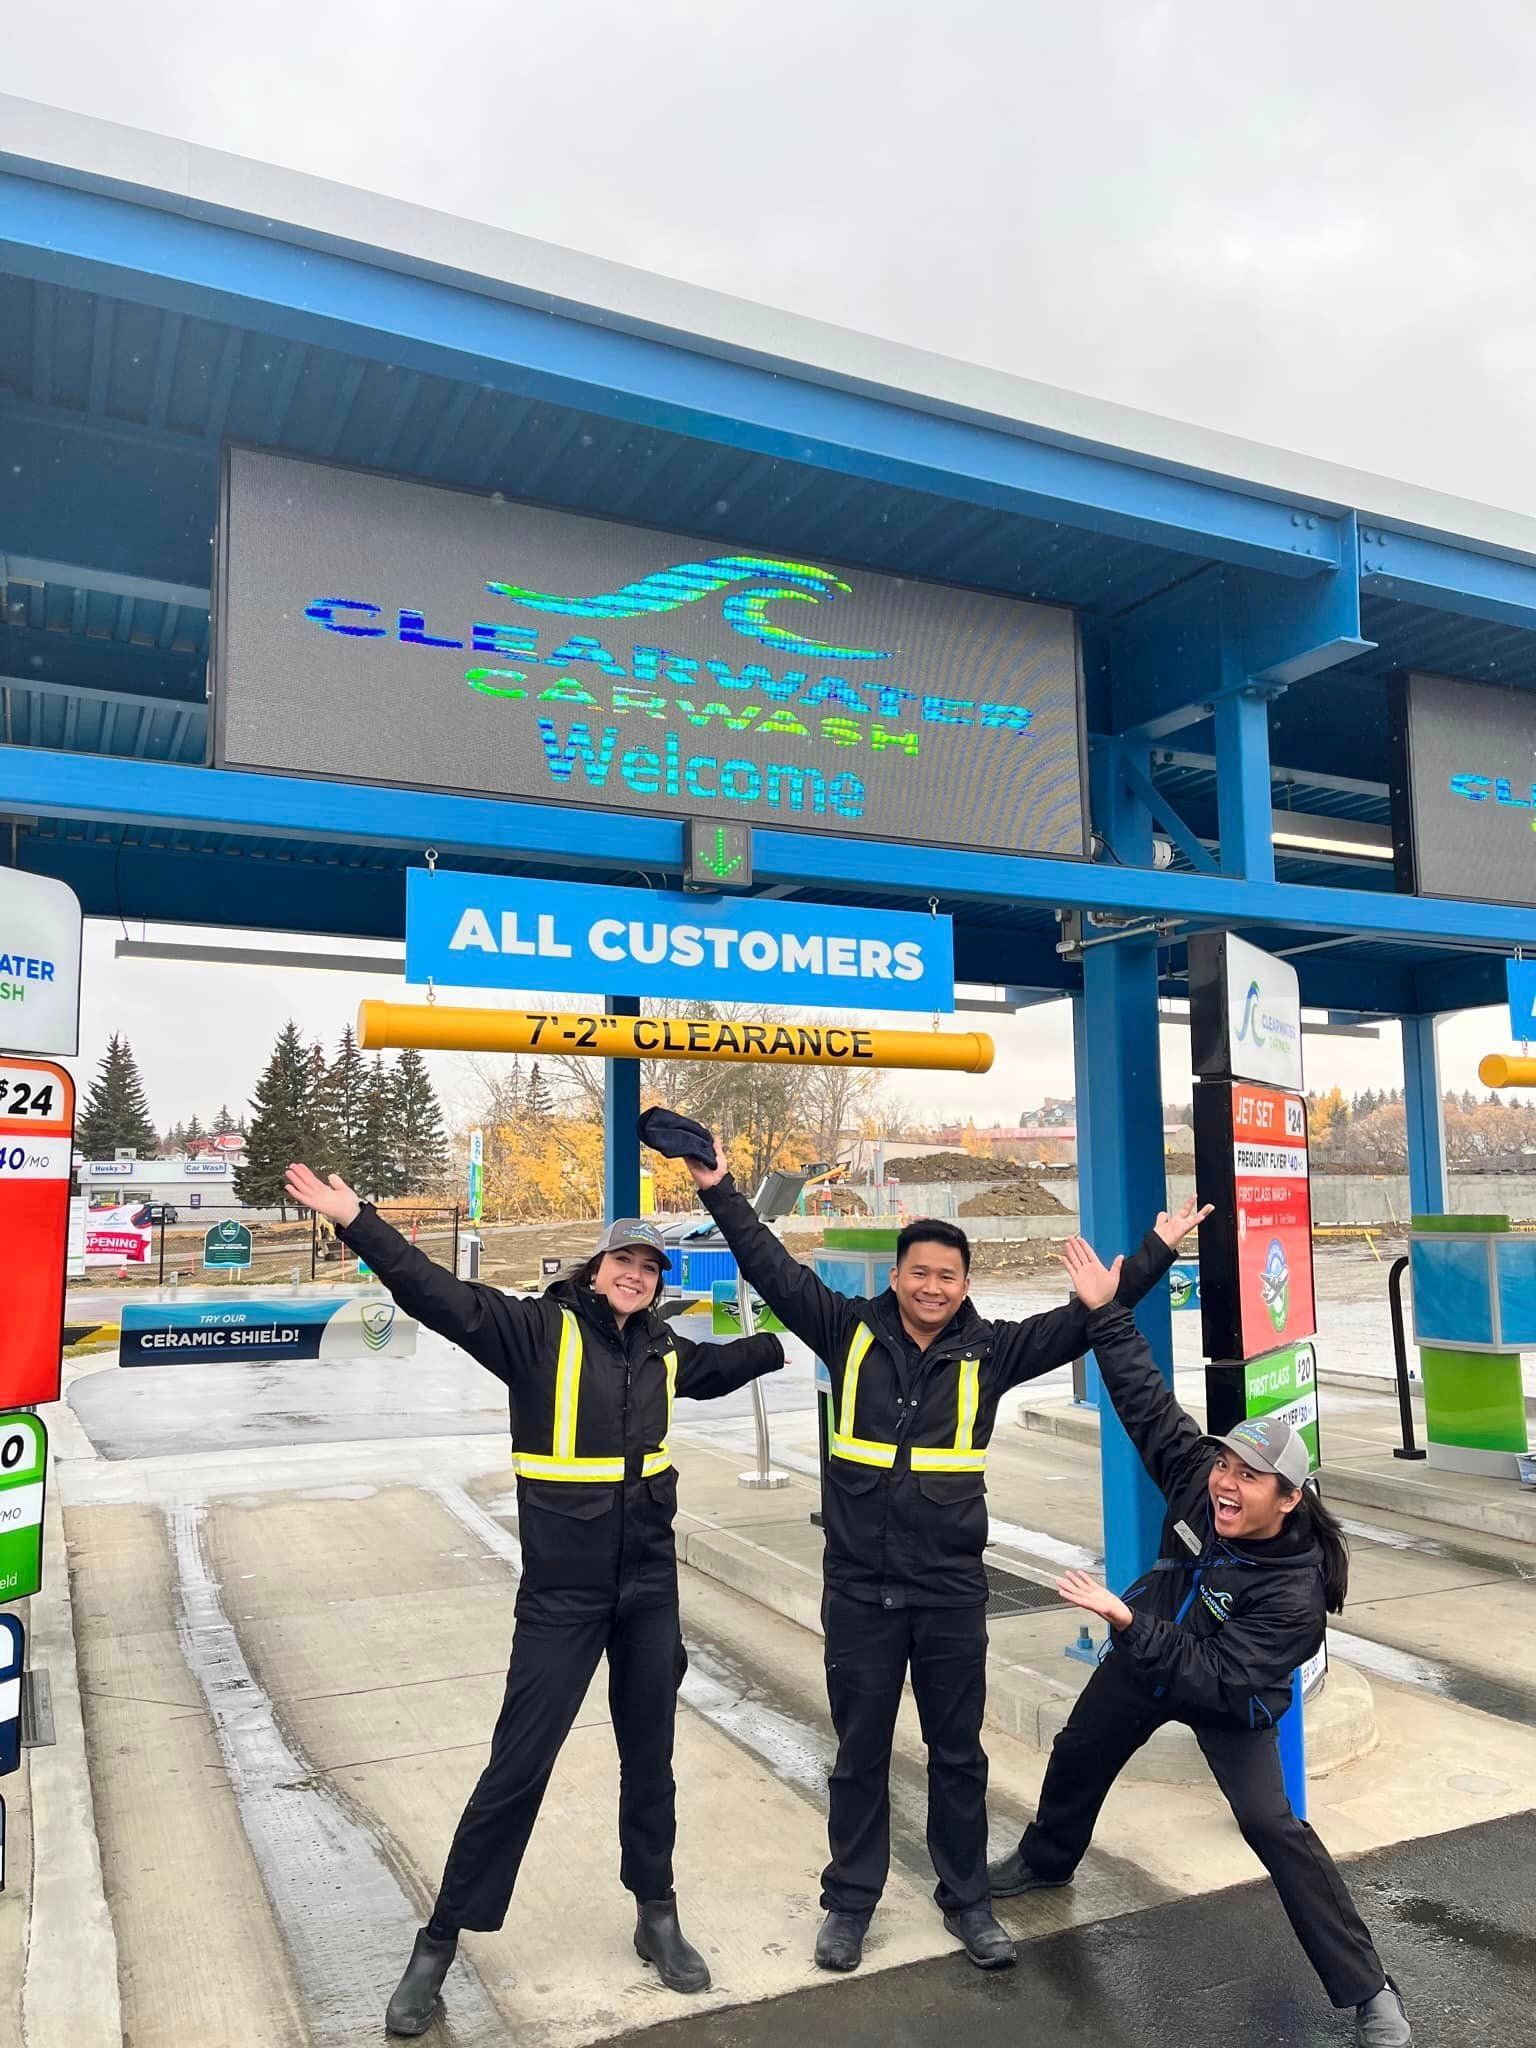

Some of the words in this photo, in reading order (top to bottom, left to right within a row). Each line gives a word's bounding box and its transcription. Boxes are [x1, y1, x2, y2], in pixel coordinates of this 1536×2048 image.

[304, 597, 1035, 737] CLEARWATER
[465, 667, 920, 756] CARWASH
[537, 716, 866, 818] Welcome
[1450, 773, 1536, 809] CL
[449, 908, 573, 958] ALL
[588, 918, 925, 981] CUSTOMERS
[633, 1019, 874, 1059] CLEARANCE
[0, 1079, 53, 1116] $24
[1236, 1096, 1255, 1126] JET
[1256, 1099, 1275, 1129] SET
[95, 1164, 118, 1173] Husky
[202, 1163, 224, 1171] Wash
[1237, 1149, 1269, 1169] FREQUENT
[1270, 1152, 1287, 1169] FLYER
[200, 1315, 219, 1324] TRY
[221, 1314, 246, 1323] OUR
[140, 1328, 225, 1348] CERAMIC
[230, 1328, 299, 1345] SHIELD!
[1200, 1585, 1232, 1620] CLEARWATE
